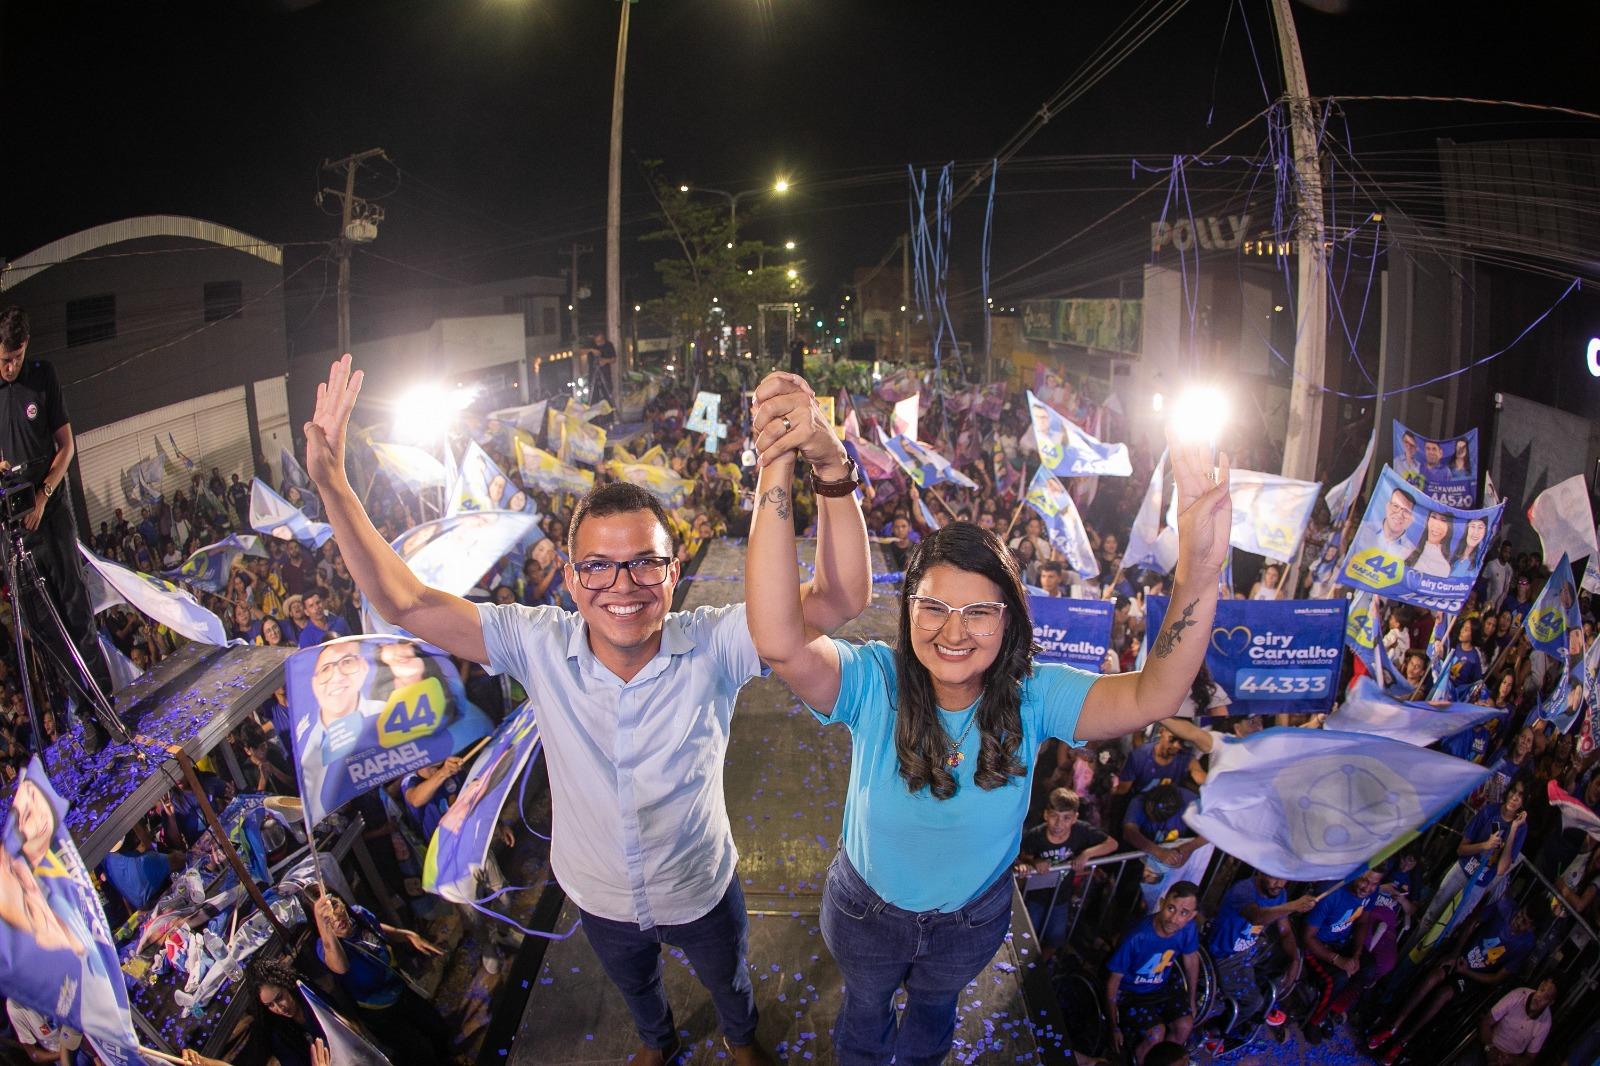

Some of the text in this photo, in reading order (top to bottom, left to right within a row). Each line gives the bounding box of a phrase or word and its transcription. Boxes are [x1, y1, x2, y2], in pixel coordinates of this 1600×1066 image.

[686, 391, 727, 453] 4
[1365, 555, 1398, 579] 44
[1249, 646, 1339, 659] Carvalho
[1240, 676, 1327, 693] 44333
[384, 693, 437, 734] 44
[348, 742, 429, 783] RAFAEL
